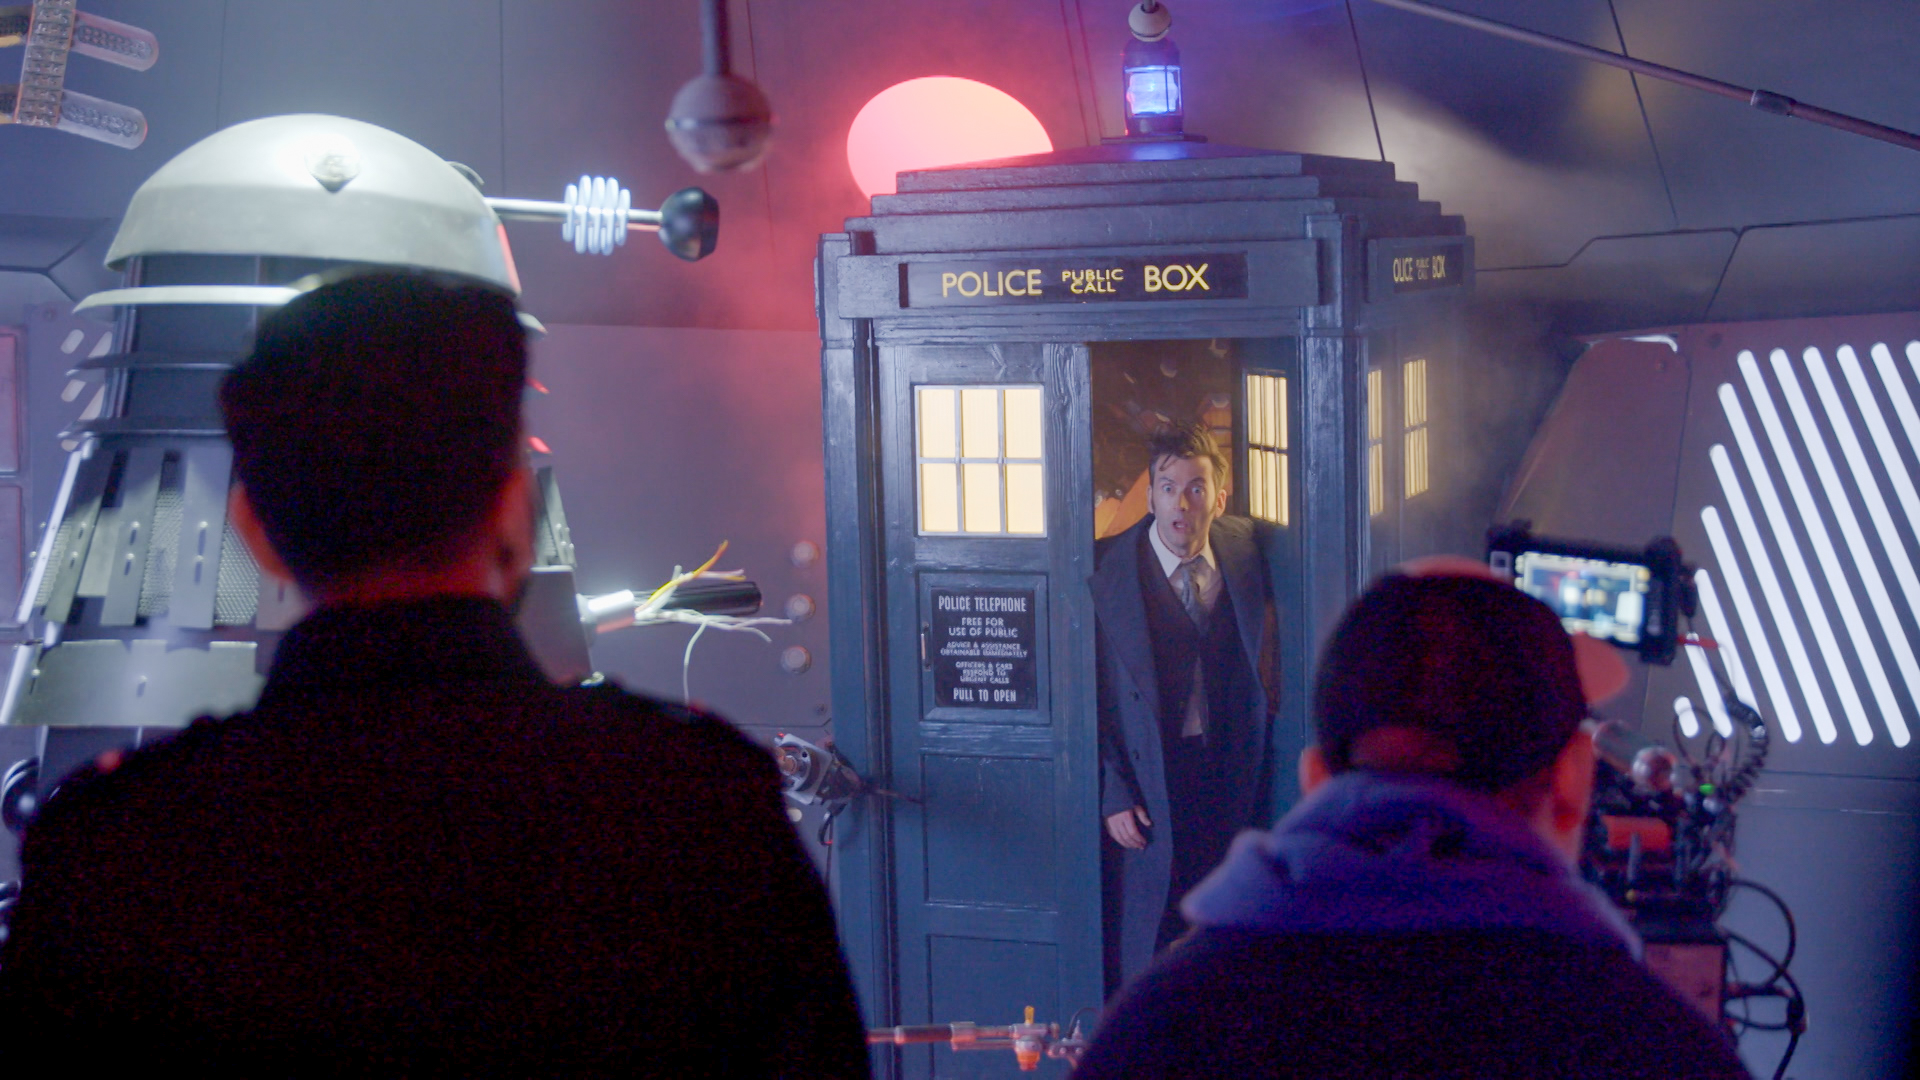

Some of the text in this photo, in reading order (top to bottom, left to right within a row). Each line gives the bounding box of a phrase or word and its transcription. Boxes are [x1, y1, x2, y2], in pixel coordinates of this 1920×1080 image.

[1393, 257, 1413, 282] OLICE
[942, 263, 1210, 298] POLICE PUBLIC CALL BOX
[938, 595, 1027, 612] POLICE TELEPHONE
[961, 617, 1004, 627] FREE FOR
[948, 627, 1019, 638] USE OF PUBLIC
[953, 687, 1017, 702] PULL TO OPEN
